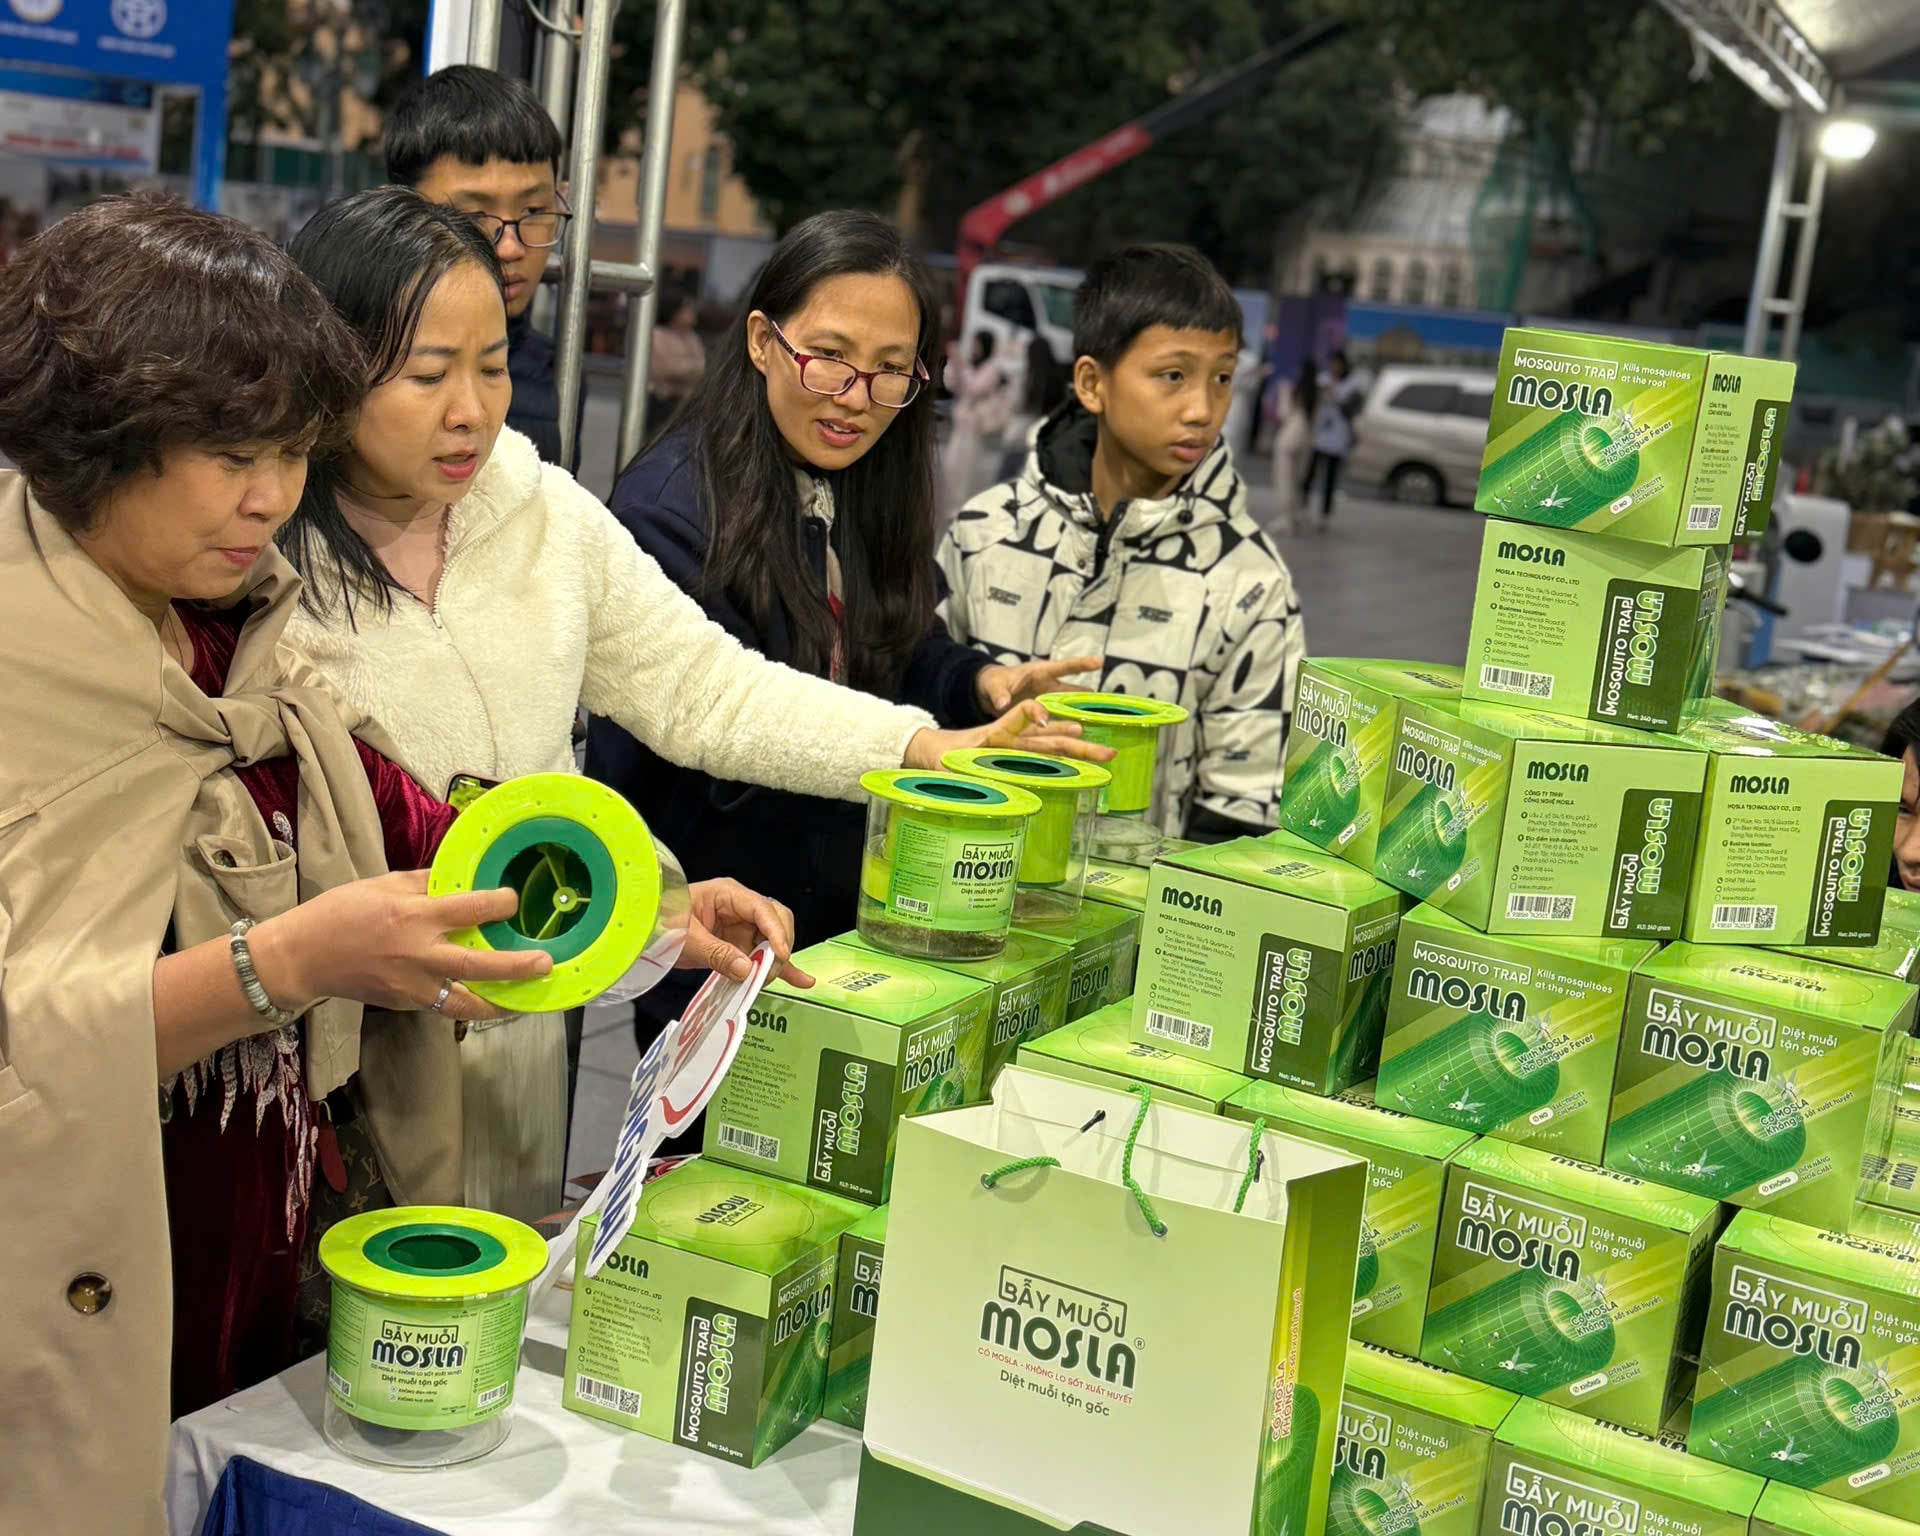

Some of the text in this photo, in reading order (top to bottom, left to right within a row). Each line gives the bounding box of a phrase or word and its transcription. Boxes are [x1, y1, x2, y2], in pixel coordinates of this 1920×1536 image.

[1516, 355, 1616, 380] MOSQUITO TRAP
[1621, 374, 1667, 388] at the root
[1623, 362, 1691, 381] Kills mosquitoes
[1712, 373, 1742, 393] MOSLA
[1508, 374, 1614, 417] MOSLA
[1602, 423, 1651, 457] With MOSLA
[1605, 420, 1673, 466] No Dengue Fever
[1751, 408, 1777, 501] MOSLA
[1498, 541, 1566, 567] MOSLA
[1495, 568, 1516, 577] MOSLA
[1625, 590, 1664, 686] MOSLA
[1605, 599, 1634, 715] MOSQUITO TRAP
[1296, 703, 1347, 748] MOSLA
[1402, 725, 1459, 755] MOSQUITO TRAP
[1396, 742, 1456, 792] MOSLA
[1527, 761, 1589, 782] MOSLA
[1730, 775, 1790, 794] MOSLA
[1636, 798, 1672, 894] MOSLA
[1837, 808, 1872, 902] MOSLA
[952, 860, 1014, 880] MOSLA
[1820, 819, 1847, 936] MOSQUITO TRAP
[1159, 913, 1178, 922] MOSLA
[1162, 886, 1223, 917] MOSLA
[1349, 938, 1397, 983] MOSLA
[1416, 948, 1531, 985] MOSQUITO TRAP
[1069, 965, 1110, 1004] MOSLA
[1277, 947, 1312, 1046] MOSLA
[1408, 967, 1527, 1024] MOSLA
[1535, 980, 1586, 999] at the root
[1537, 968, 1613, 994] Kills mosquitoes
[746, 1008, 788, 1034] OSLA
[994, 1002, 1041, 1046] MOSLA
[1260, 955, 1285, 1072] MOSQUITO TRAP
[1651, 1000, 1774, 1049] BẪY MUỖI
[907, 1020, 959, 1062] BẪY MUỖI
[1517, 1034, 1571, 1065] With MOSLA
[1521, 1033, 1595, 1074] No Dengue Fever
[1641, 1022, 1772, 1083] MOSLA
[1780, 1038, 1825, 1058] tận gốc
[1782, 1025, 1838, 1048] Diệt muỗi
[902, 1044, 956, 1094] MOSLA
[836, 1062, 868, 1155] MOSLA
[1760, 1098, 1810, 1126] Có MOSLA
[1765, 1117, 1798, 1136] Không
[1372, 1176, 1393, 1189] gốc
[1378, 1166, 1404, 1180] muỗi
[1465, 1192, 1585, 1249] BẪY MUỖI
[1456, 1216, 1581, 1283] MOSLA
[1589, 1238, 1633, 1261] tận gốc
[1592, 1225, 1646, 1251] Diệt muỗi
[604, 1250, 649, 1279] OSLA
[778, 1274, 816, 1308] MOSQUITO
[1000, 1278, 1127, 1338] BẪY MUỖI
[1733, 1278, 1866, 1335] BẪY MUỖI
[774, 1282, 832, 1346] MOSLA
[1571, 1300, 1618, 1326] Có MOSLA
[1576, 1318, 1607, 1337] Không
[1873, 1310, 1900, 1326] Diệt
[980, 1301, 1136, 1389] MOSLA
[1724, 1301, 1861, 1370] MOSLA
[1871, 1325, 1919, 1345] tận gốc
[372, 1339, 465, 1369] MOSLA
[704, 1312, 738, 1415] MOSLA
[686, 1320, 710, 1442] MOSQUITO TRAP
[978, 1346, 991, 1357] CÓ
[992, 1351, 1019, 1367] MOSLA
[1025, 1363, 1054, 1379] KHÔNG
[1055, 1373, 1067, 1382] LO
[1067, 1374, 1084, 1388] SỐT
[1085, 1383, 1106, 1397] XUẤT
[1106, 1389, 1133, 1405] HUYẾT
[1274, 1360, 1286, 1414] MOSLA
[1000, 1369, 1111, 1417] Diệt muỗi tận gốc
[1851, 1389, 1903, 1416] Có MOSLA
[1856, 1407, 1890, 1426] Không
[1395, 1439, 1437, 1459] tận gốc
[1397, 1424, 1449, 1450] Diệt muỗi
[1335, 1436, 1387, 1481] SLA
[1378, 1500, 1424, 1525] Có MOSLA
[1510, 1475, 1561, 1509] BẪY
[1566, 1495, 1638, 1533] MUỖI
[1384, 1518, 1412, 1535] Không
[1645, 1510, 1702, 1536] Diệt muỗi
